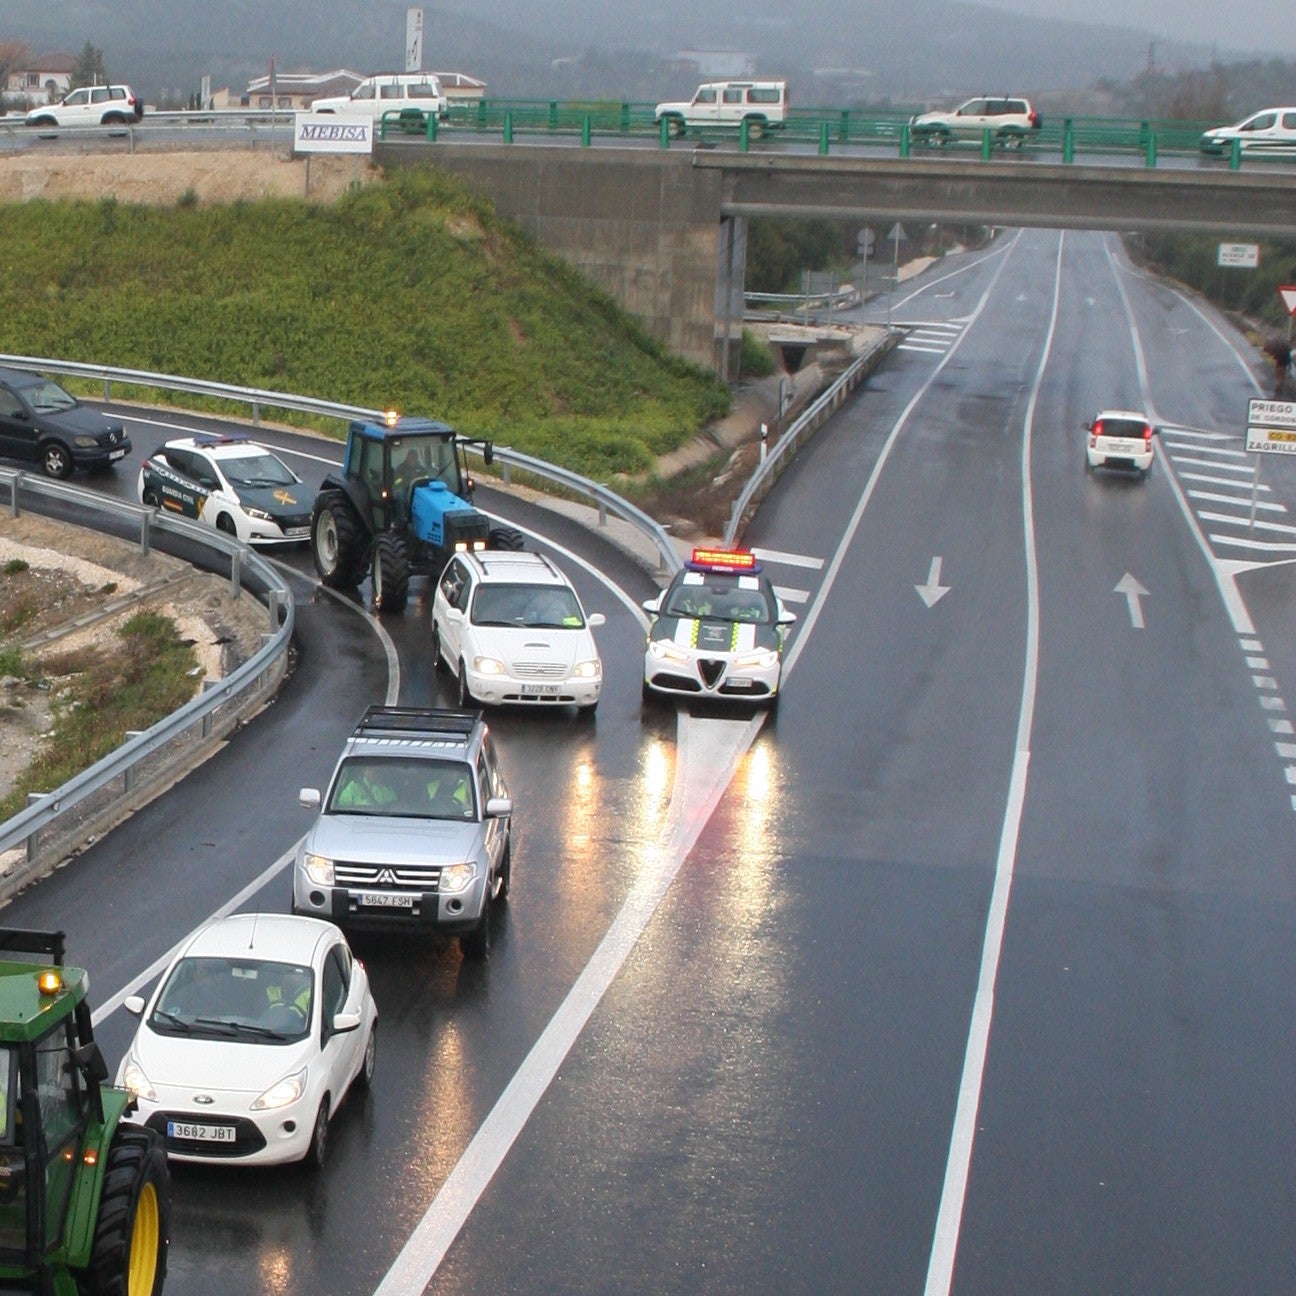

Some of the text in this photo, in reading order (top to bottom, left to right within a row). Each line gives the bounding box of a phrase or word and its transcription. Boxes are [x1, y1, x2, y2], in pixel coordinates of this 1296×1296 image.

[299, 124, 368, 141] MEBISA
[1251, 403, 1293, 414] PRIEGO
[1248, 442, 1296, 452] ZAGRILL
[210, 1127, 233, 1140] JBT
